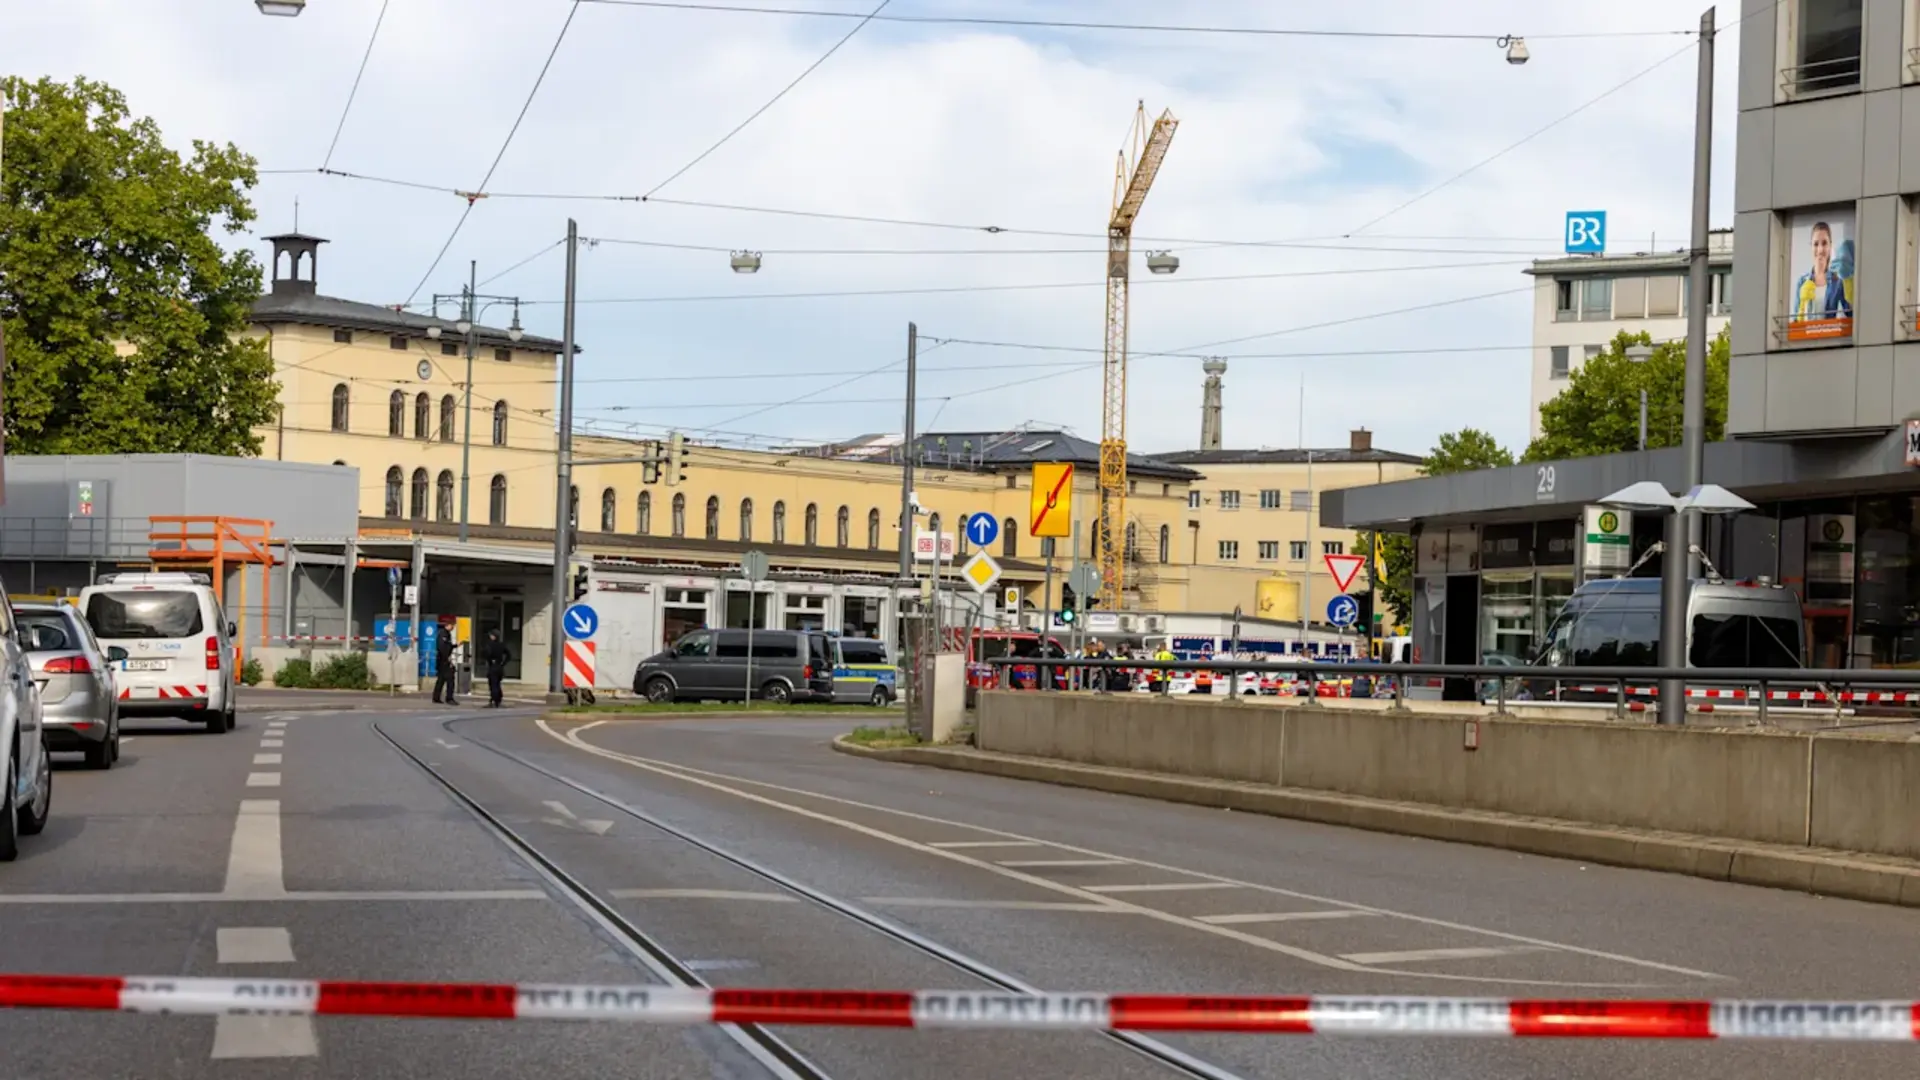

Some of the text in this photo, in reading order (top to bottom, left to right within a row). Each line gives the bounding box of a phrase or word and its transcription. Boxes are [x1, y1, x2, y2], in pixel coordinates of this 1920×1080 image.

[1568, 217, 1602, 246] BR
[1536, 466, 1556, 492] 29
[1046, 491, 1057, 509] U
[919, 539, 933, 552] DB
